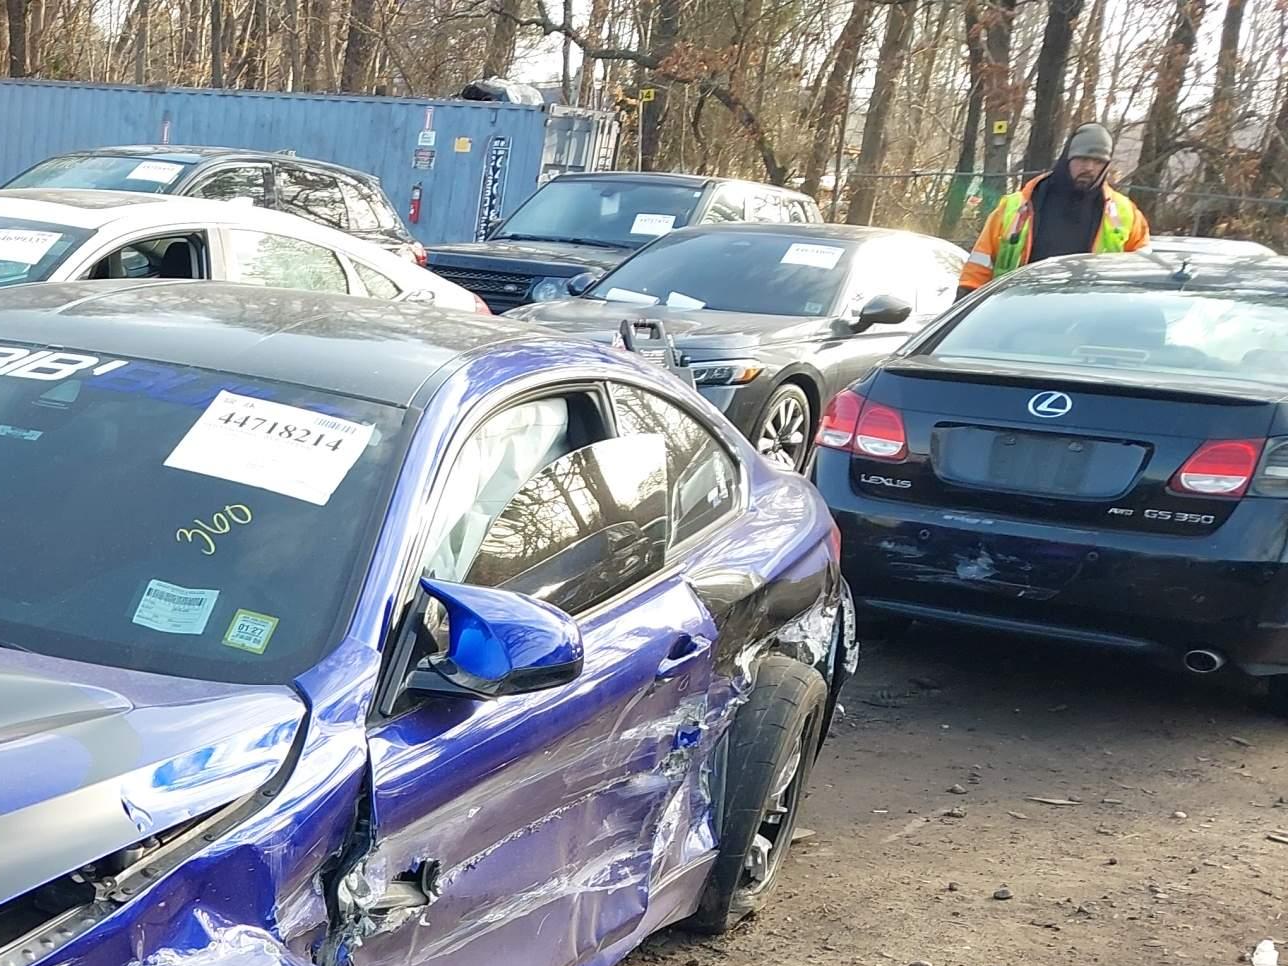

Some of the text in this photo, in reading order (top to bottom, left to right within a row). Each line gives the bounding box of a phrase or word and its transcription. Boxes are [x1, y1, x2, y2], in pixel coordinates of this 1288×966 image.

[218, 410, 344, 452] 44718214
[860, 473, 913, 489] LEXUS
[175, 503, 253, 556] 360
[1143, 508, 1172, 520] GS
[1173, 512, 1216, 525] 350
